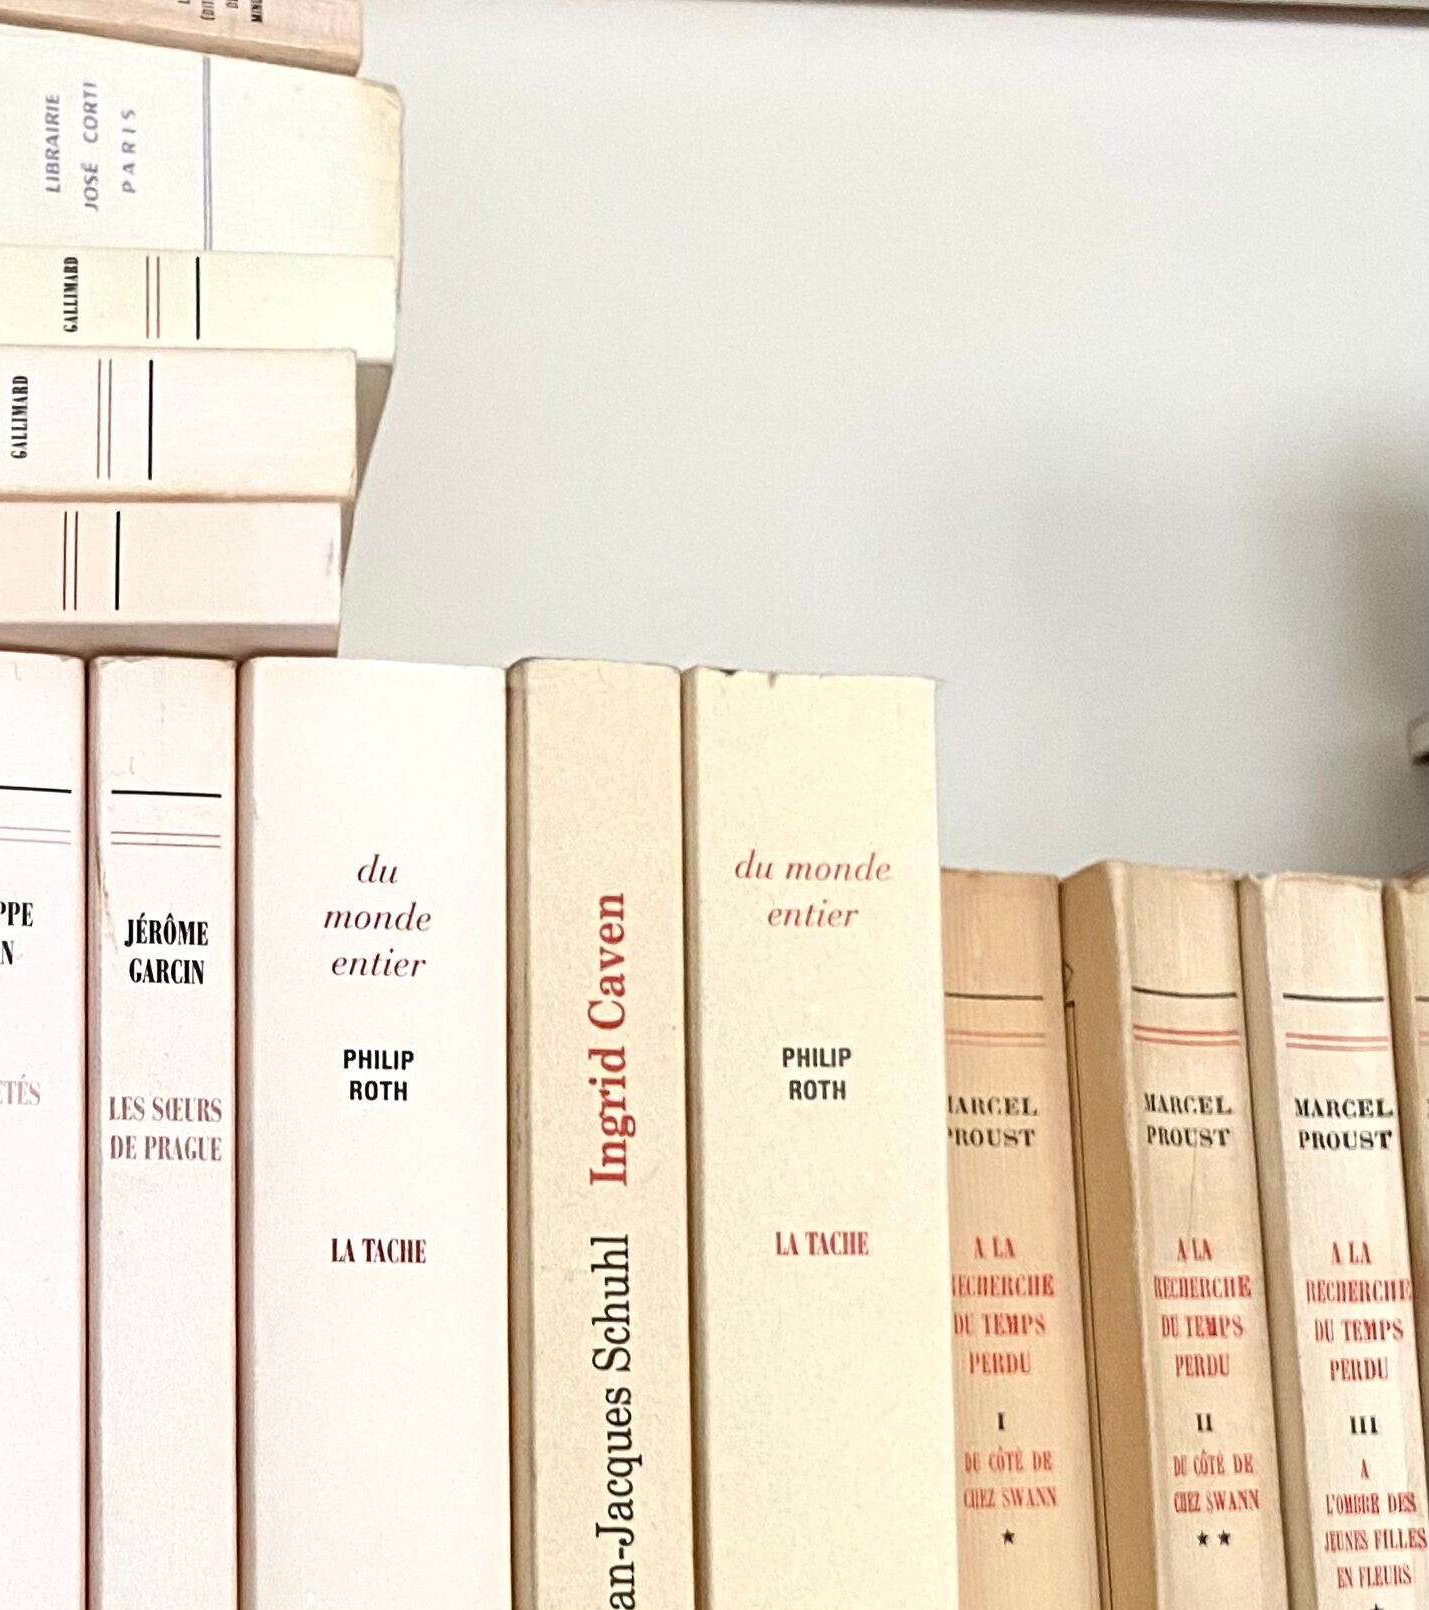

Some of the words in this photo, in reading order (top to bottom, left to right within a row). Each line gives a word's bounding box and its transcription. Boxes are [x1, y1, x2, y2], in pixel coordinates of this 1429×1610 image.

[82, 80, 98, 146] CORTI
[45, 91, 62, 193] LIBRAIRIE
[121, 107, 138, 194] PARIS
[82, 160, 100, 212] JOSÉ
[62, 255, 80, 333] GALLIMARD
[10, 373, 31, 461] GALLIMARD
[356, 852, 400, 886] du
[733, 850, 776, 883] du
[785, 853, 893, 883] monde
[323, 902, 433, 934] monde
[767, 899, 860, 929] entier
[124, 913, 210, 948] JÉRÔME
[128, 957, 207, 986] GARCIN
[330, 949, 428, 980] entier
[587, 891, 628, 1030] Caven
[341, 1048, 416, 1072] PHILIP
[781, 1047, 853, 1070] PHILIP
[348, 1078, 410, 1103] ROTH
[789, 1078, 848, 1101] ROTH
[108, 1094, 148, 1123] LES
[151, 1095, 224, 1125] SŒURS
[947, 1095, 1039, 1118] ARCEL
[1143, 1093, 1233, 1116] MARCEL
[1294, 1097, 1394, 1120] MARCEL
[588, 1047, 638, 1188] Ingrid
[946, 1128, 1036, 1148] ROUST
[1146, 1125, 1230, 1148] PROUST
[1298, 1130, 1393, 1151] PROUST
[109, 1135, 140, 1162] DE
[143, 1135, 223, 1164] PRAGUE
[329, 1238, 357, 1265] LA
[362, 1238, 428, 1265] TACHE
[774, 1231, 800, 1257] LA
[804, 1231, 871, 1257] TACHE
[973, 1237, 984, 1259] A
[991, 1237, 1016, 1260] LA
[1176, 1238, 1187, 1262] A
[1191, 1238, 1212, 1262] LA
[1330, 1242, 1342, 1266] A
[1348, 1241, 1371, 1265] LA
[1153, 1274, 1253, 1300] RECHERCHE
[1305, 1278, 1412, 1303] RECHERCHE
[590, 1233, 632, 1373] Schuhl
[954, 1313, 976, 1336] DU
[982, 1312, 1047, 1336] TEMPS
[1160, 1315, 1180, 1339] DU
[1185, 1313, 1244, 1339] TEMPS
[1314, 1320, 1335, 1343] DU
[1341, 1317, 1404, 1342] TEMPS
[968, 1352, 1032, 1376] PERDU
[1174, 1354, 1230, 1378] PERDU
[1328, 1358, 1389, 1383] PERDU
[996, 1412, 1005, 1432] I
[1195, 1412, 1213, 1433] II
[1350, 1415, 1379, 1435] III
[963, 1451, 982, 1474] DU
[988, 1447, 1025, 1474] CÔTÉ
[1032, 1449, 1053, 1472] DE
[1173, 1454, 1189, 1477] DU
[1193, 1449, 1226, 1477] CÔTÉ
[1232, 1453, 1255, 1474] DE
[1360, 1458, 1369, 1481] A
[963, 1488, 997, 1510] CHEZ
[1002, 1486, 1058, 1509] SWANN
[1173, 1491, 1202, 1514] CHEZ
[1206, 1489, 1260, 1512] SWANN
[1325, 1492, 1380, 1516] L'OMBRE
[1387, 1491, 1417, 1514] DES
[1324, 1529, 1368, 1553] JEUNES
[1374, 1528, 1428, 1550] FILLES
[1337, 1566, 1353, 1589] EN
[1359, 1564, 1412, 1588] FLEURS
